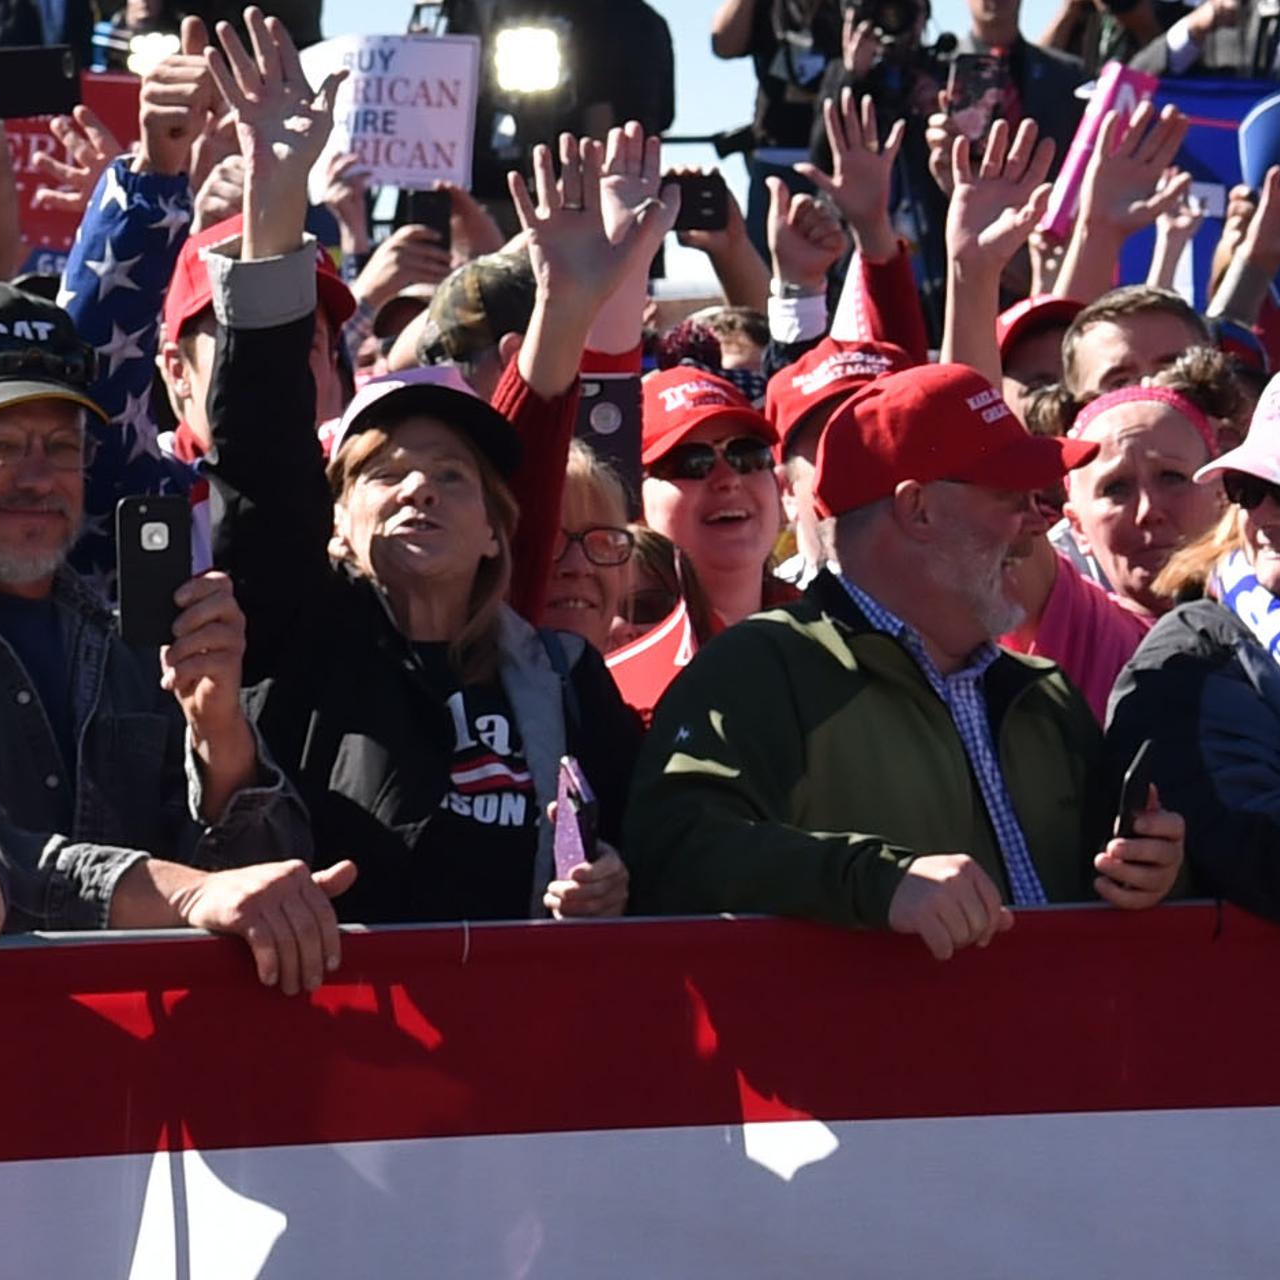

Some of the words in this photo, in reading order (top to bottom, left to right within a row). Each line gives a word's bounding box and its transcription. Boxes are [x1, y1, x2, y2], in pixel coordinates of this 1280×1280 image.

[354, 75, 462, 109] RICAN
[349, 138, 456, 169] RICAN
[440, 791, 527, 827] SON
